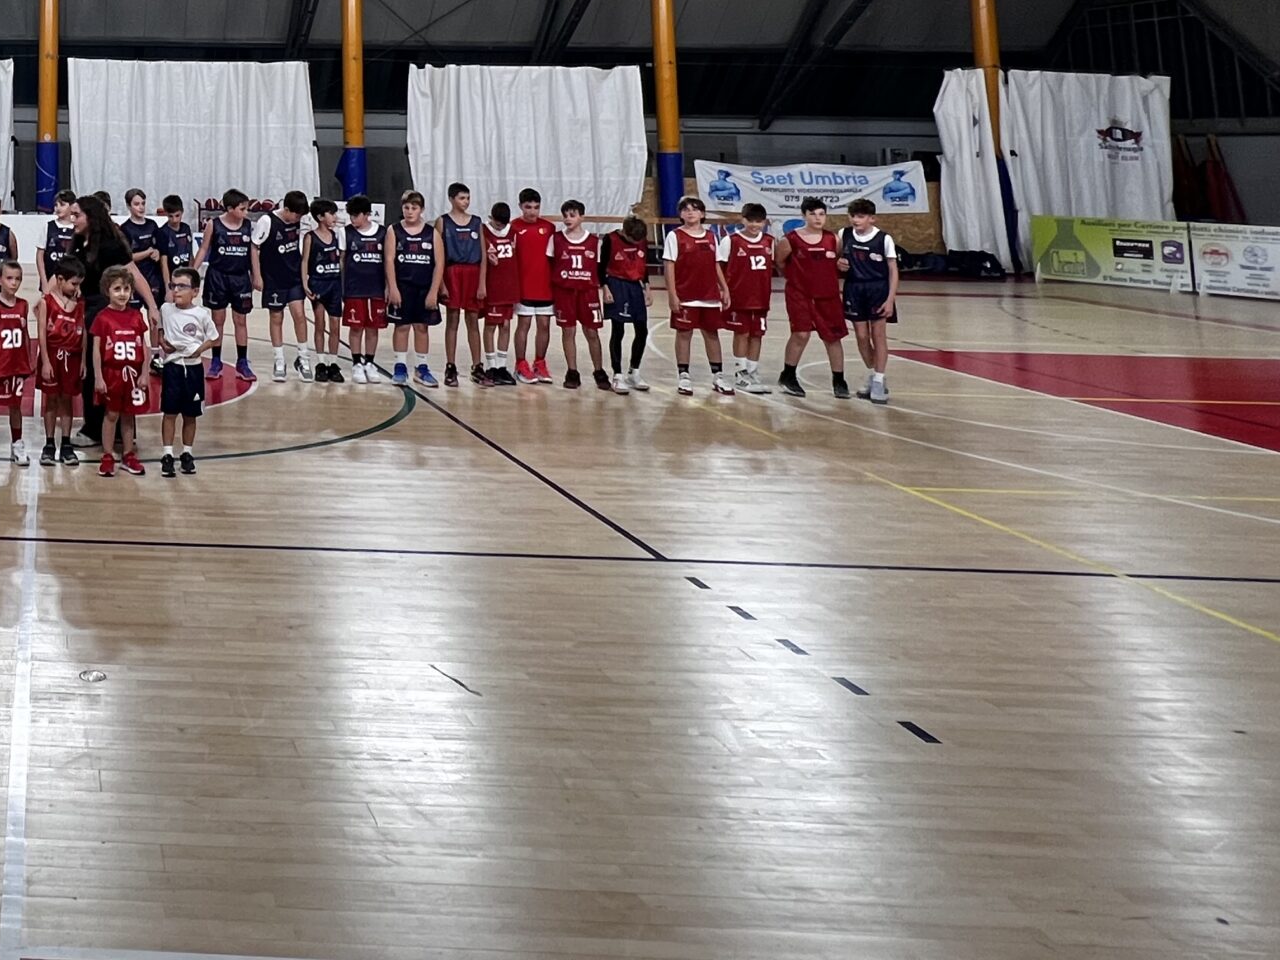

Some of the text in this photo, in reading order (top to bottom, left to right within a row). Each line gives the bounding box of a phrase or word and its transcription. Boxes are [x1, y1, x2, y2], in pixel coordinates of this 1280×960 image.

[750, 171, 869, 185] Saet Umbria
[497, 245, 512, 258] 23
[571, 255, 582, 269] 11
[749, 255, 767, 270] 12
[1, 328, 23, 349] 20
[114, 342, 136, 360] 95
